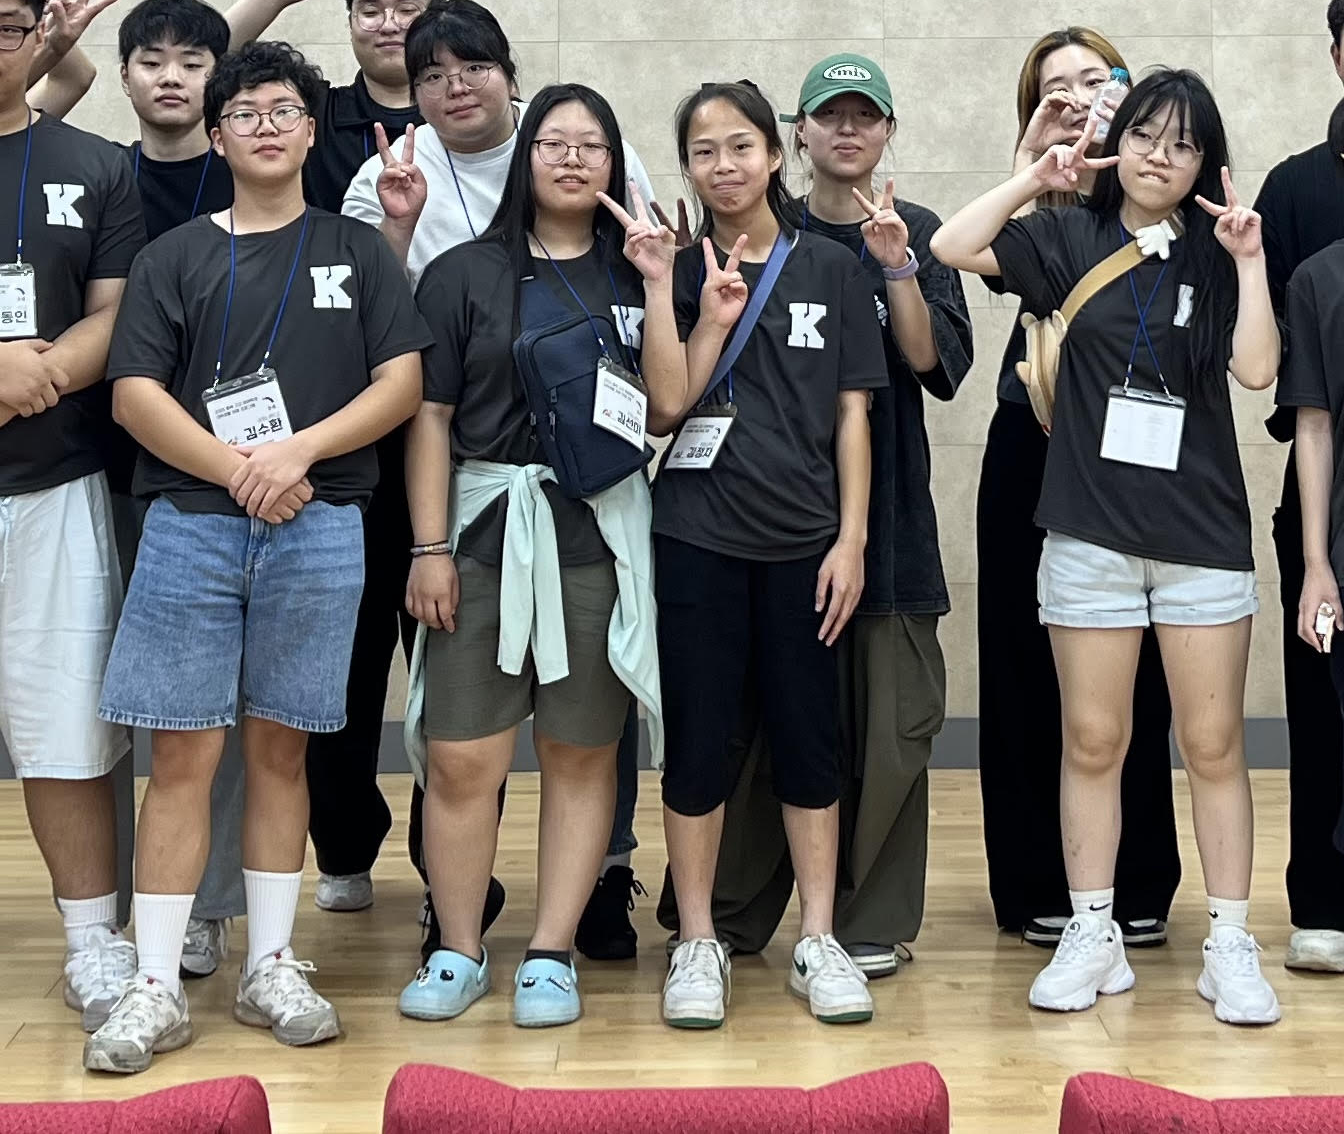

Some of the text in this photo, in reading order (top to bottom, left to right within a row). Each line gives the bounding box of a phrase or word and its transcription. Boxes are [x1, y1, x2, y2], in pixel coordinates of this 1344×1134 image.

[42, 183, 85, 229] K
[309, 264, 352, 309] K
[787, 302, 827, 349] K
[243, 418, 283, 440] 김수환
